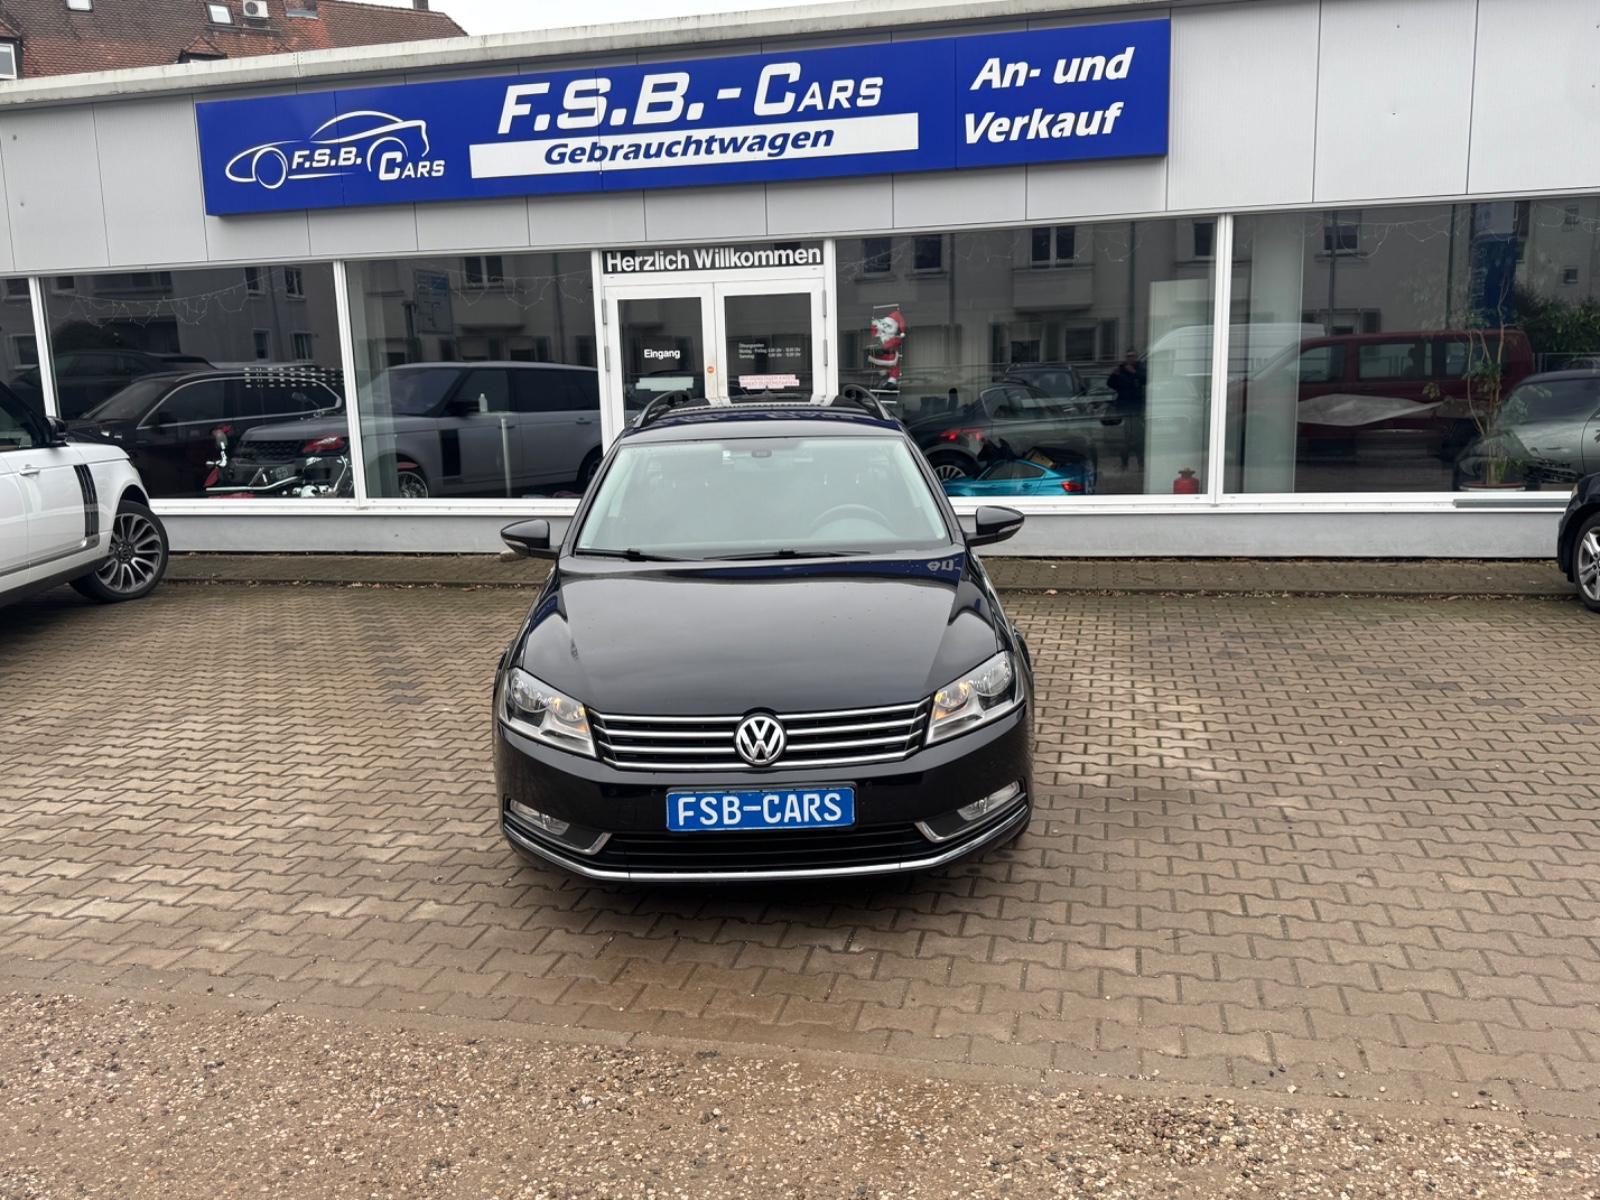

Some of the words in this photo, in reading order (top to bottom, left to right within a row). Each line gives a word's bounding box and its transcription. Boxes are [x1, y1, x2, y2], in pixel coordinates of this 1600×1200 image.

[970, 57, 1041, 90] An-
[1053, 47, 1135, 84] und
[965, 102, 1124, 143] Verkauf
[292, 147, 362, 169] F.S.B.
[544, 127, 834, 165] Gebrauchtwagen
[607, 251, 689, 272] Herzlich
[694, 247, 821, 269] Willkommen
[644, 348, 680, 360] Eingang
[678, 793, 842, 826] FSB-CARS
